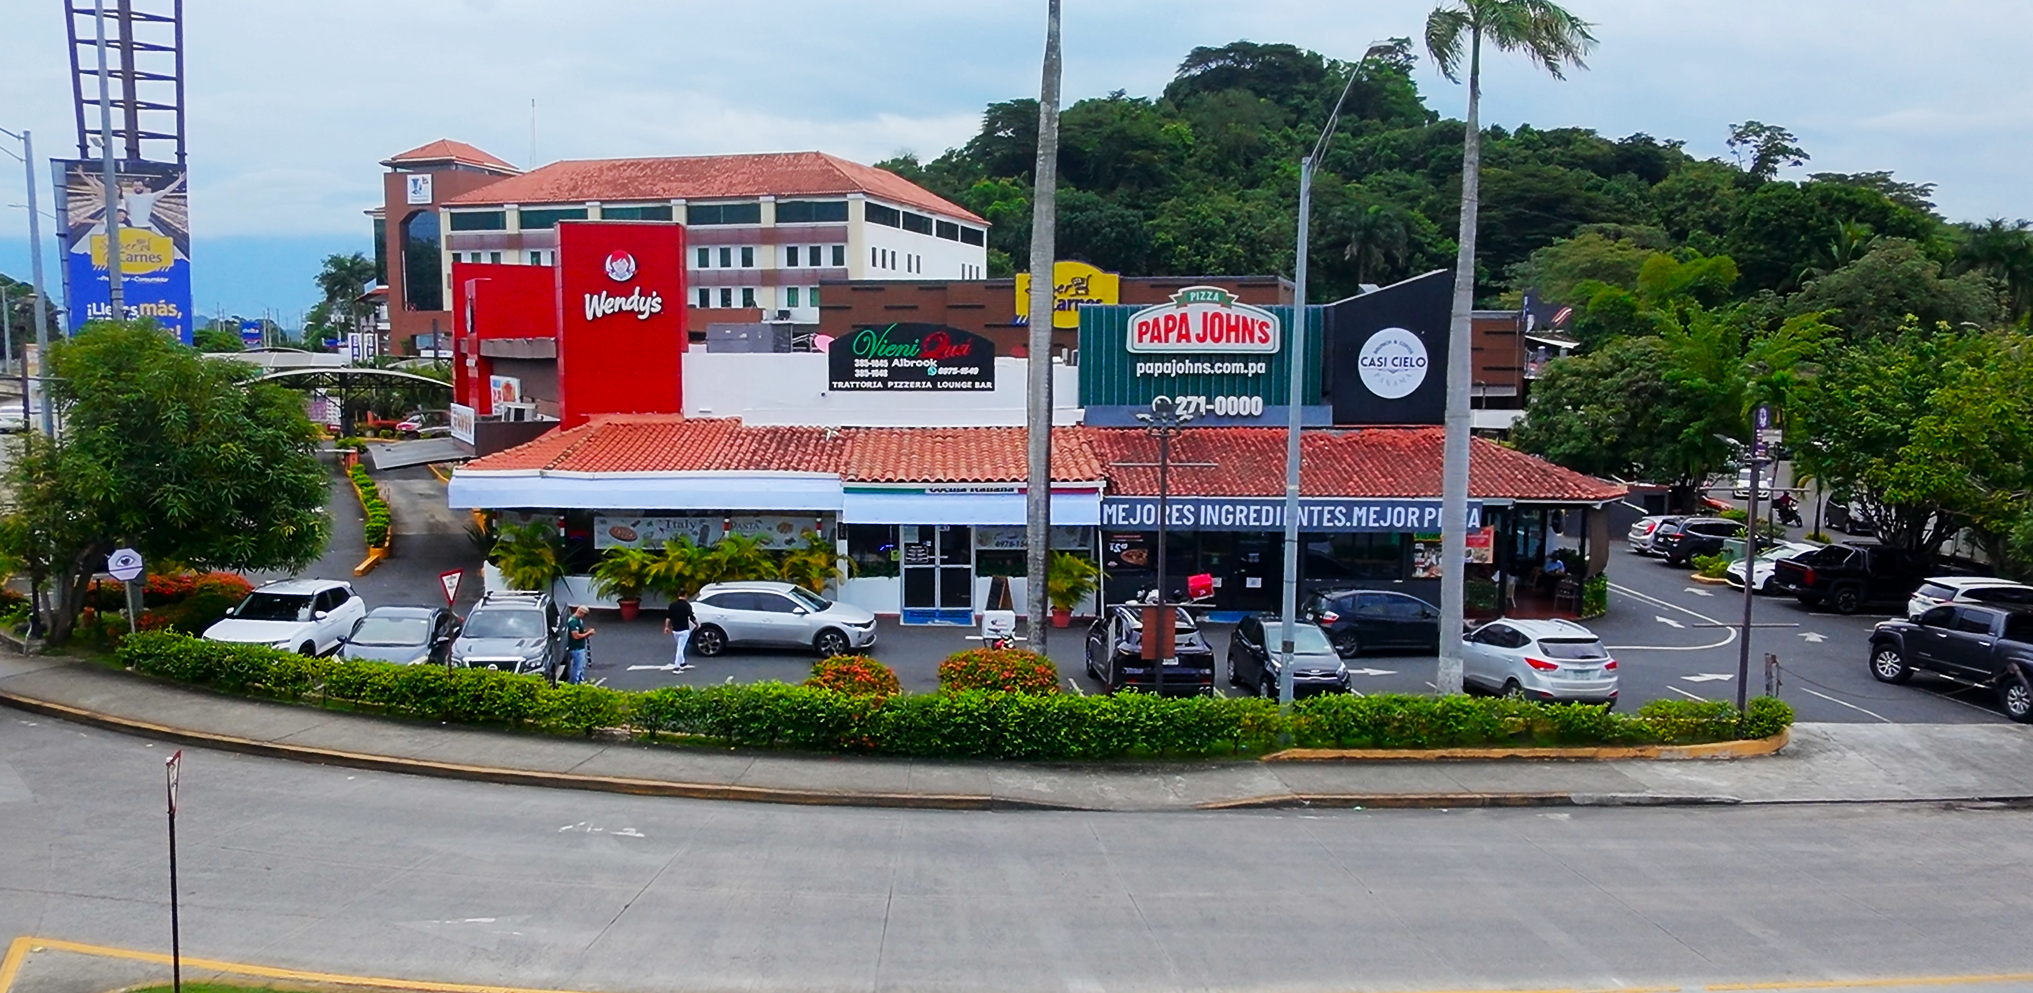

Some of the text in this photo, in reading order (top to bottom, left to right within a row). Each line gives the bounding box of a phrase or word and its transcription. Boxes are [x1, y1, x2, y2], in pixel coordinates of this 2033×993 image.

[584, 286, 663, 321] Wendy's
[1190, 291, 1219, 301] PIZZA
[140, 299, 182, 319] más,
[1137, 311, 1270, 345] PAPA JOHN'S
[853, 322, 920, 359] Vieni
[891, 358, 938, 368] Albrook
[1136, 359, 1266, 378] papajohns.com.pa
[1360, 356, 1427, 368] CASI CIELO
[832, 380, 993, 389] TRATTORIA PIZZERIA LOUNGE BAR
[1175, 396, 1264, 416] 271-0000
[1102, 504, 1482, 528] MEJORES INGREDINTES.MEJOR PIA
